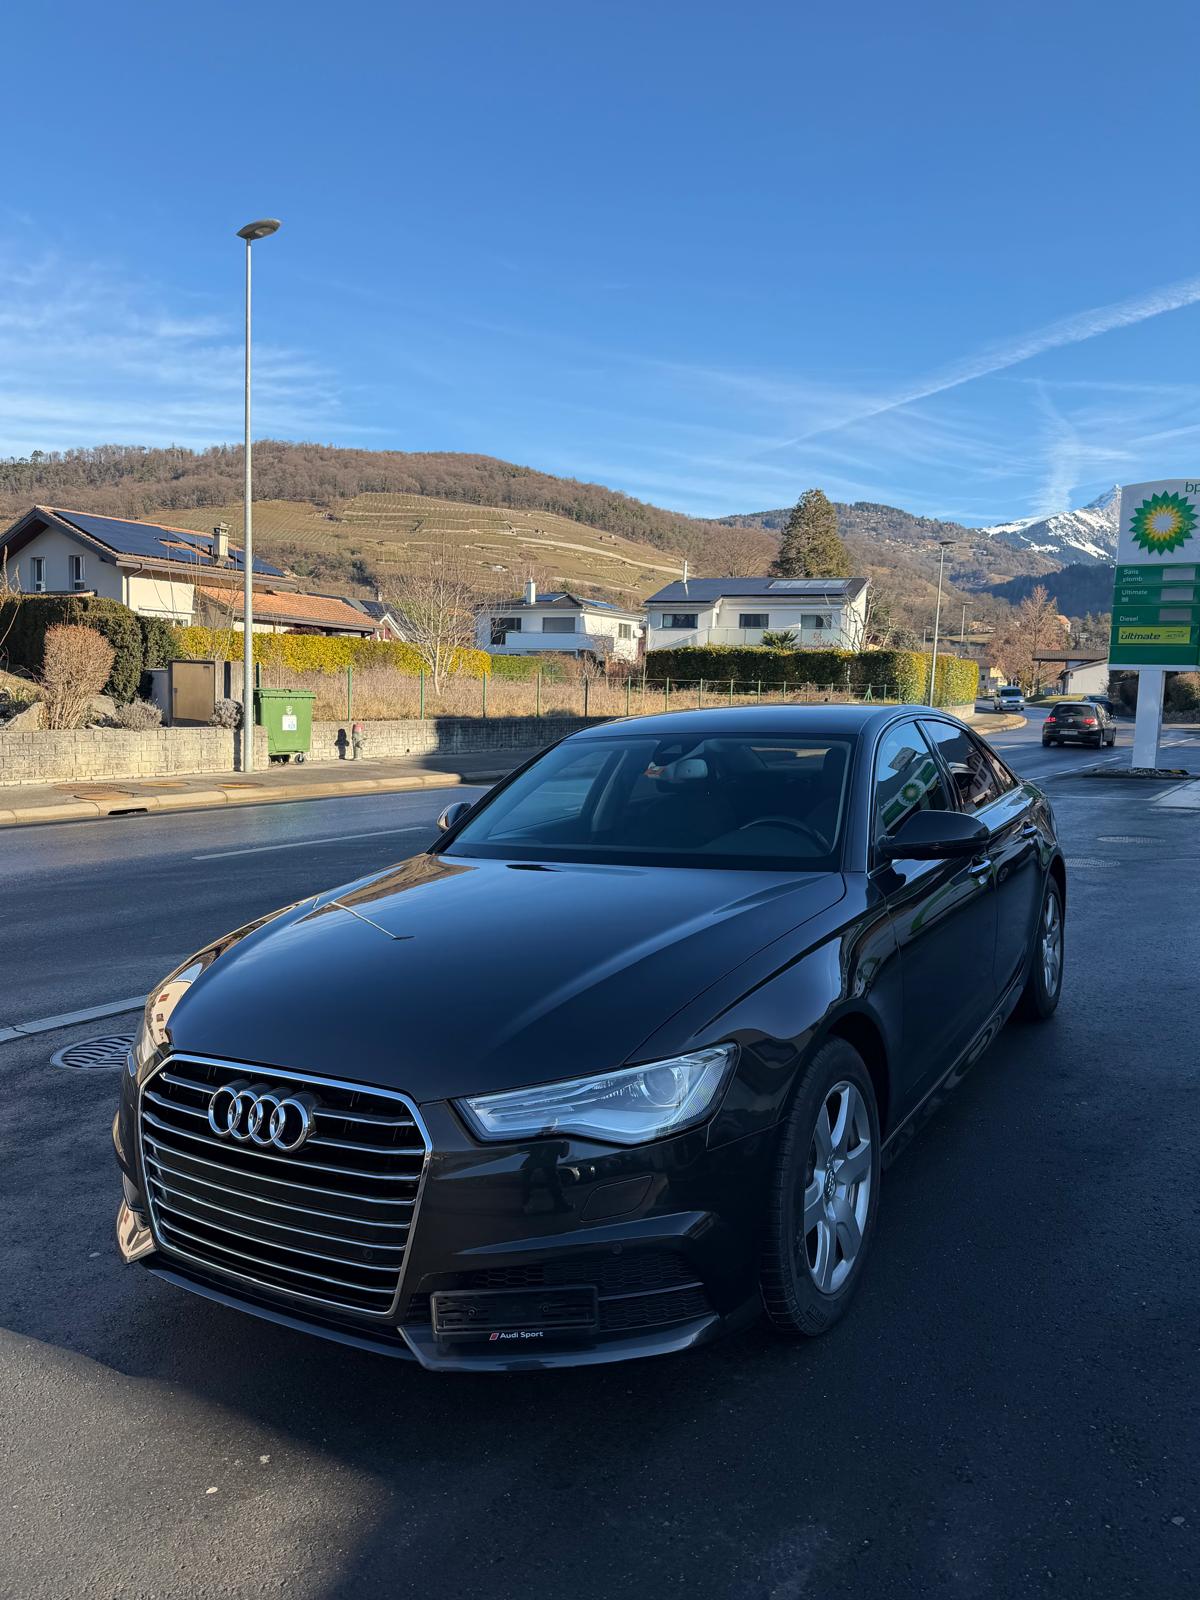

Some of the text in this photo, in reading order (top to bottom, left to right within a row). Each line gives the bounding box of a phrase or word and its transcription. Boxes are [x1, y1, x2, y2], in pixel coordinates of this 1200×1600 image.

[1185, 481, 1200, 495] bp
[1120, 632, 1161, 640] ultimate
[520, 1331, 544, 1339] Sport
